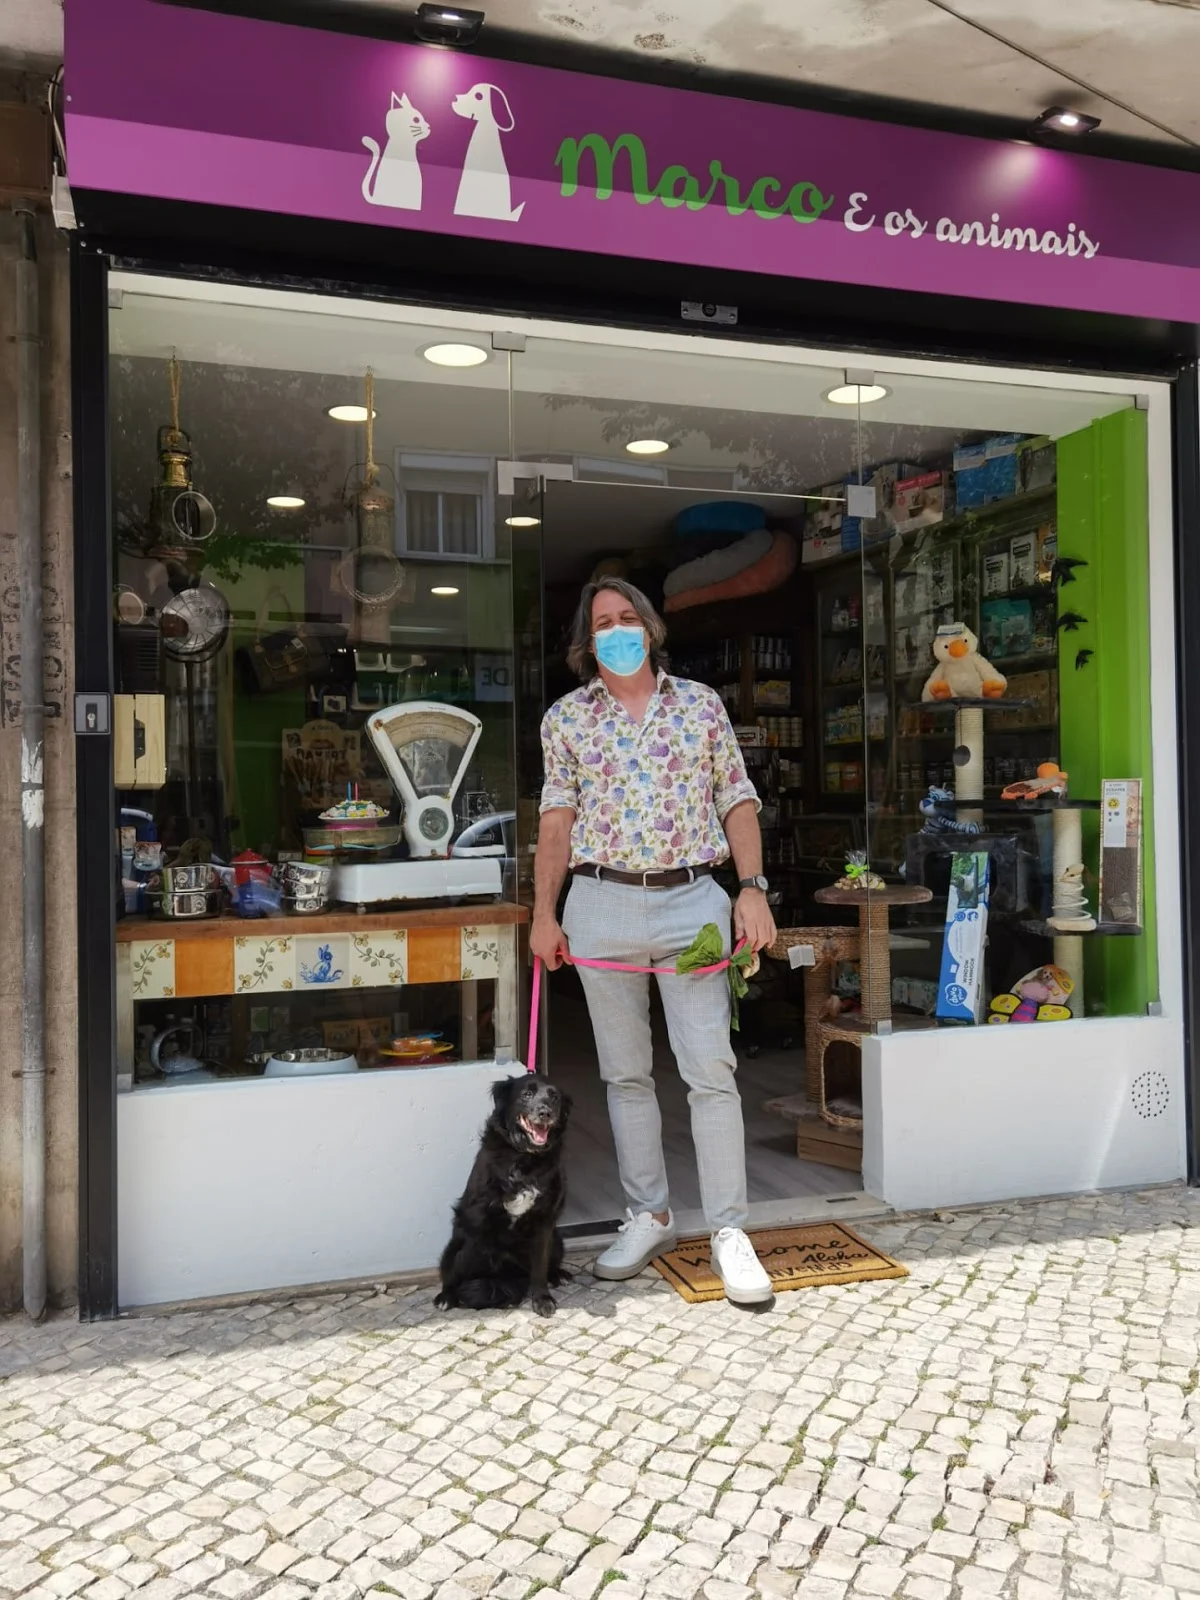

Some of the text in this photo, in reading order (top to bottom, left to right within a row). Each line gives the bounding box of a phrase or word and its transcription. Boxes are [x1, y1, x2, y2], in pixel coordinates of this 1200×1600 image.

[554, 133, 835, 223] Marco
[884, 208, 928, 239] os
[935, 213, 1100, 259] animais
[678, 1239, 850, 1267] Wcome
[802, 1251, 869, 1264] Aloha
